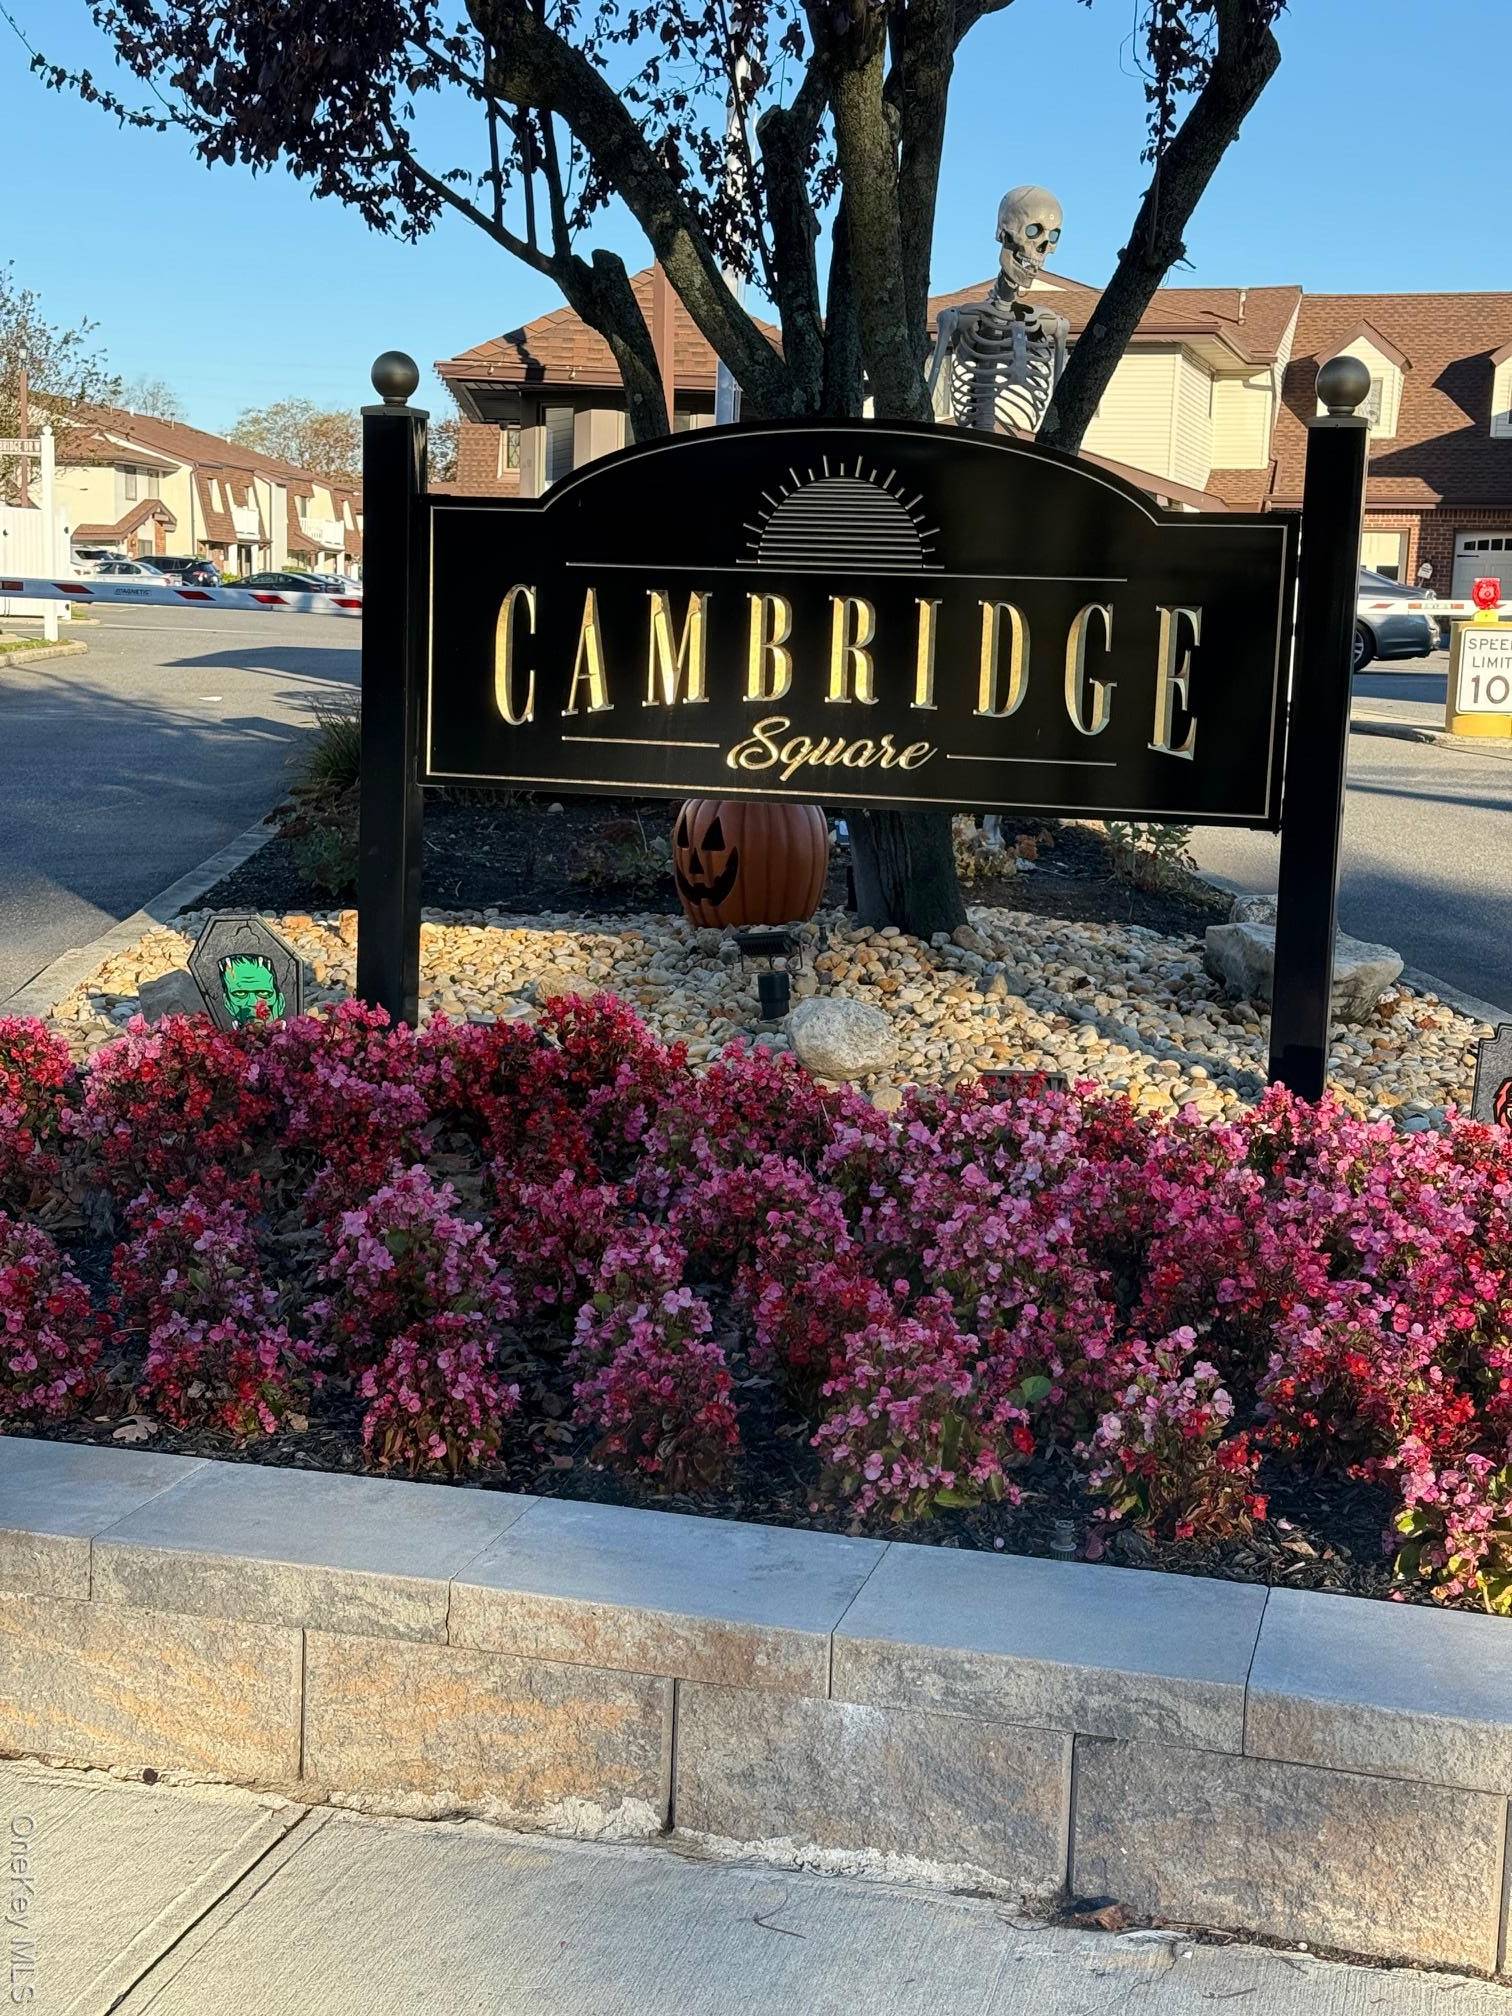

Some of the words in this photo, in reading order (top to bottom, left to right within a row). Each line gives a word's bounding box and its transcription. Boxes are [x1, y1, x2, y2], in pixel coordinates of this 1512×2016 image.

[1468, 637, 1512, 650] SPEE
[494, 583, 1203, 761] CAMBRIDGE
[1472, 655, 1512, 669] LIMIT
[1471, 674, 1510, 704] 10
[726, 715, 939, 782] Square
